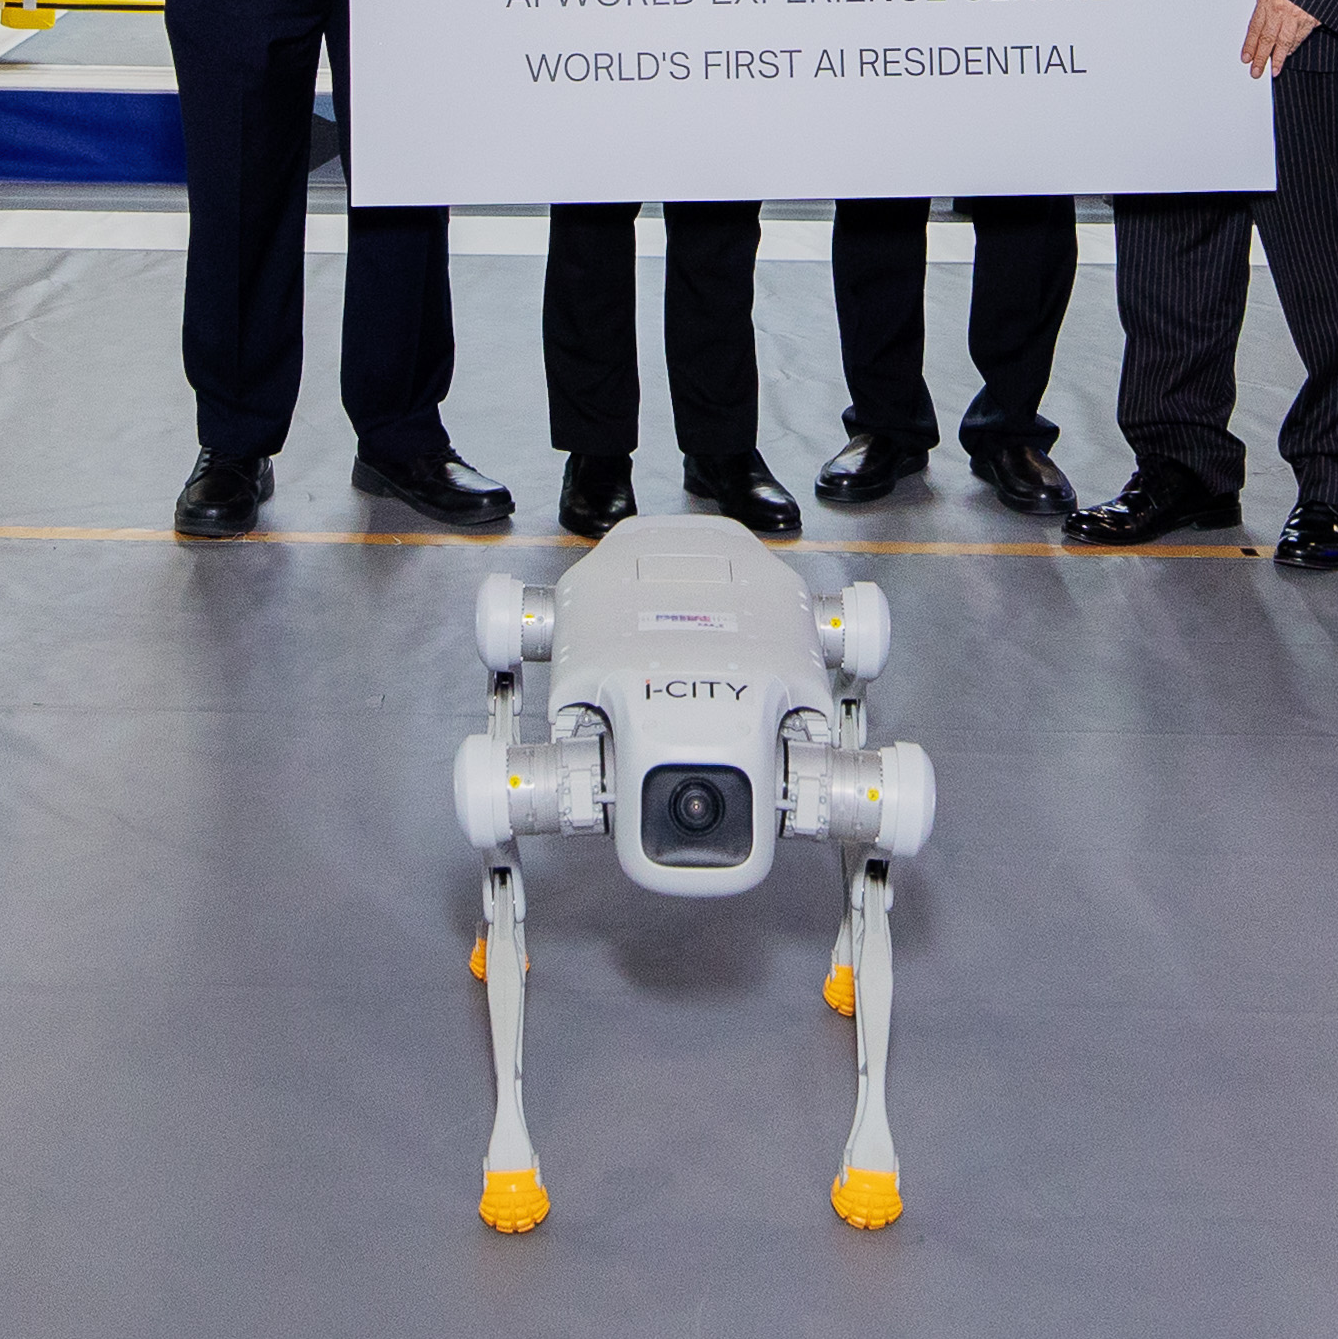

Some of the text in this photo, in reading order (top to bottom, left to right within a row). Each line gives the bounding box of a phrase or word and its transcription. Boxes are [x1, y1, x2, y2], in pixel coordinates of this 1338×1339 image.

[525, 44, 1088, 83] WORLD'S FIRST AI RESIDENTIAL
